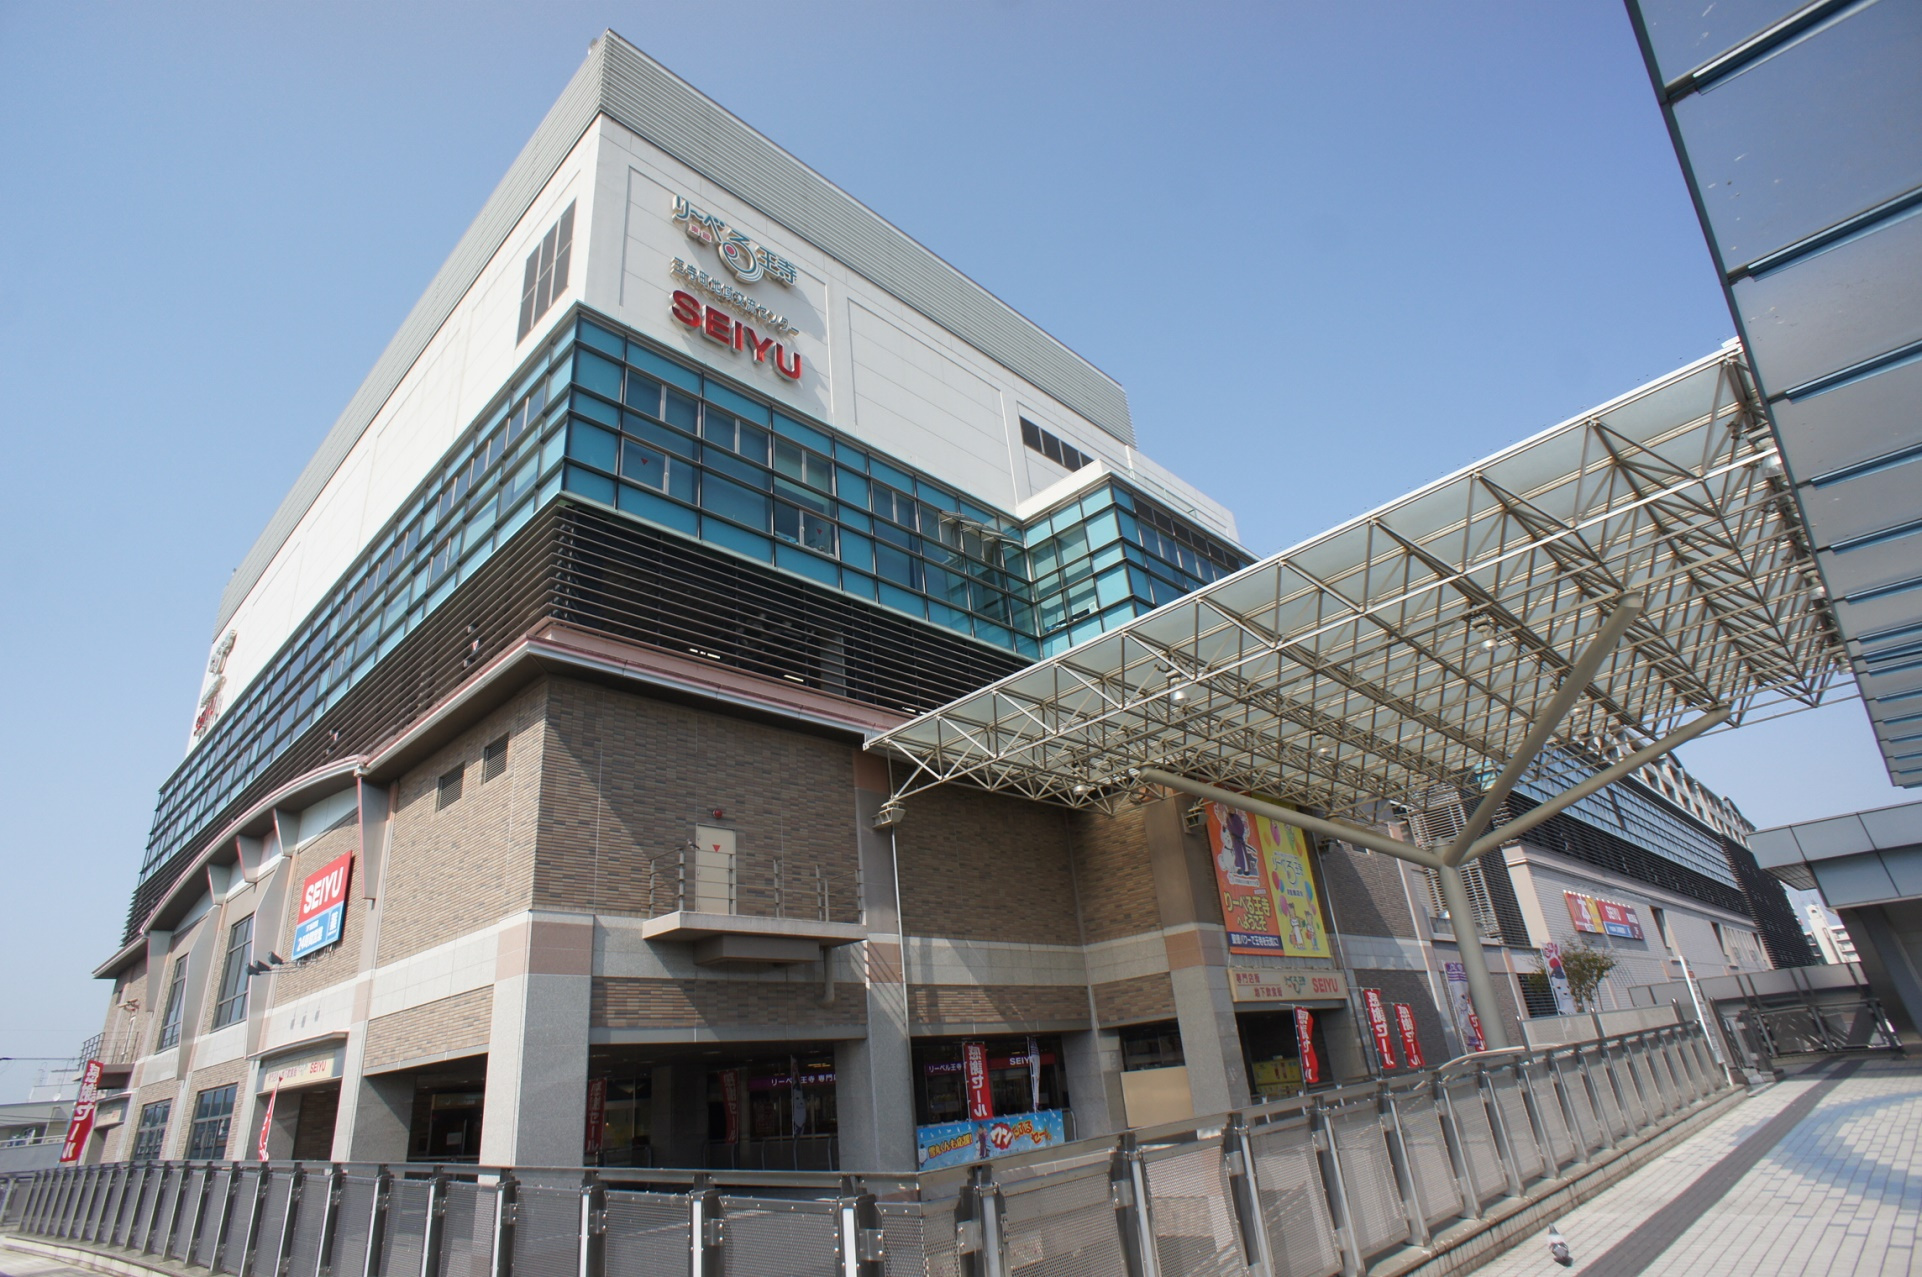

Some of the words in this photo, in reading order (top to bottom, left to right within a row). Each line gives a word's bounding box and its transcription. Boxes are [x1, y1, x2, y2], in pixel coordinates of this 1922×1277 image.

[669, 256, 800, 337] 王寺町地域交流センター
[669, 290, 803, 382] SEIYU
[303, 866, 344, 914] SEIYU
[1237, 914, 1268, 932] へようこそ
[1312, 977, 1339, 993] SEIYU
[309, 1060, 327, 1074] SEIYU
[1009, 1056, 1031, 1066] SEIY
[771, 1074, 816, 1087] リーベ王寺
[818, 1073, 836, 1082] 専門
[587, 1080, 602, 1151] 感謝セール
